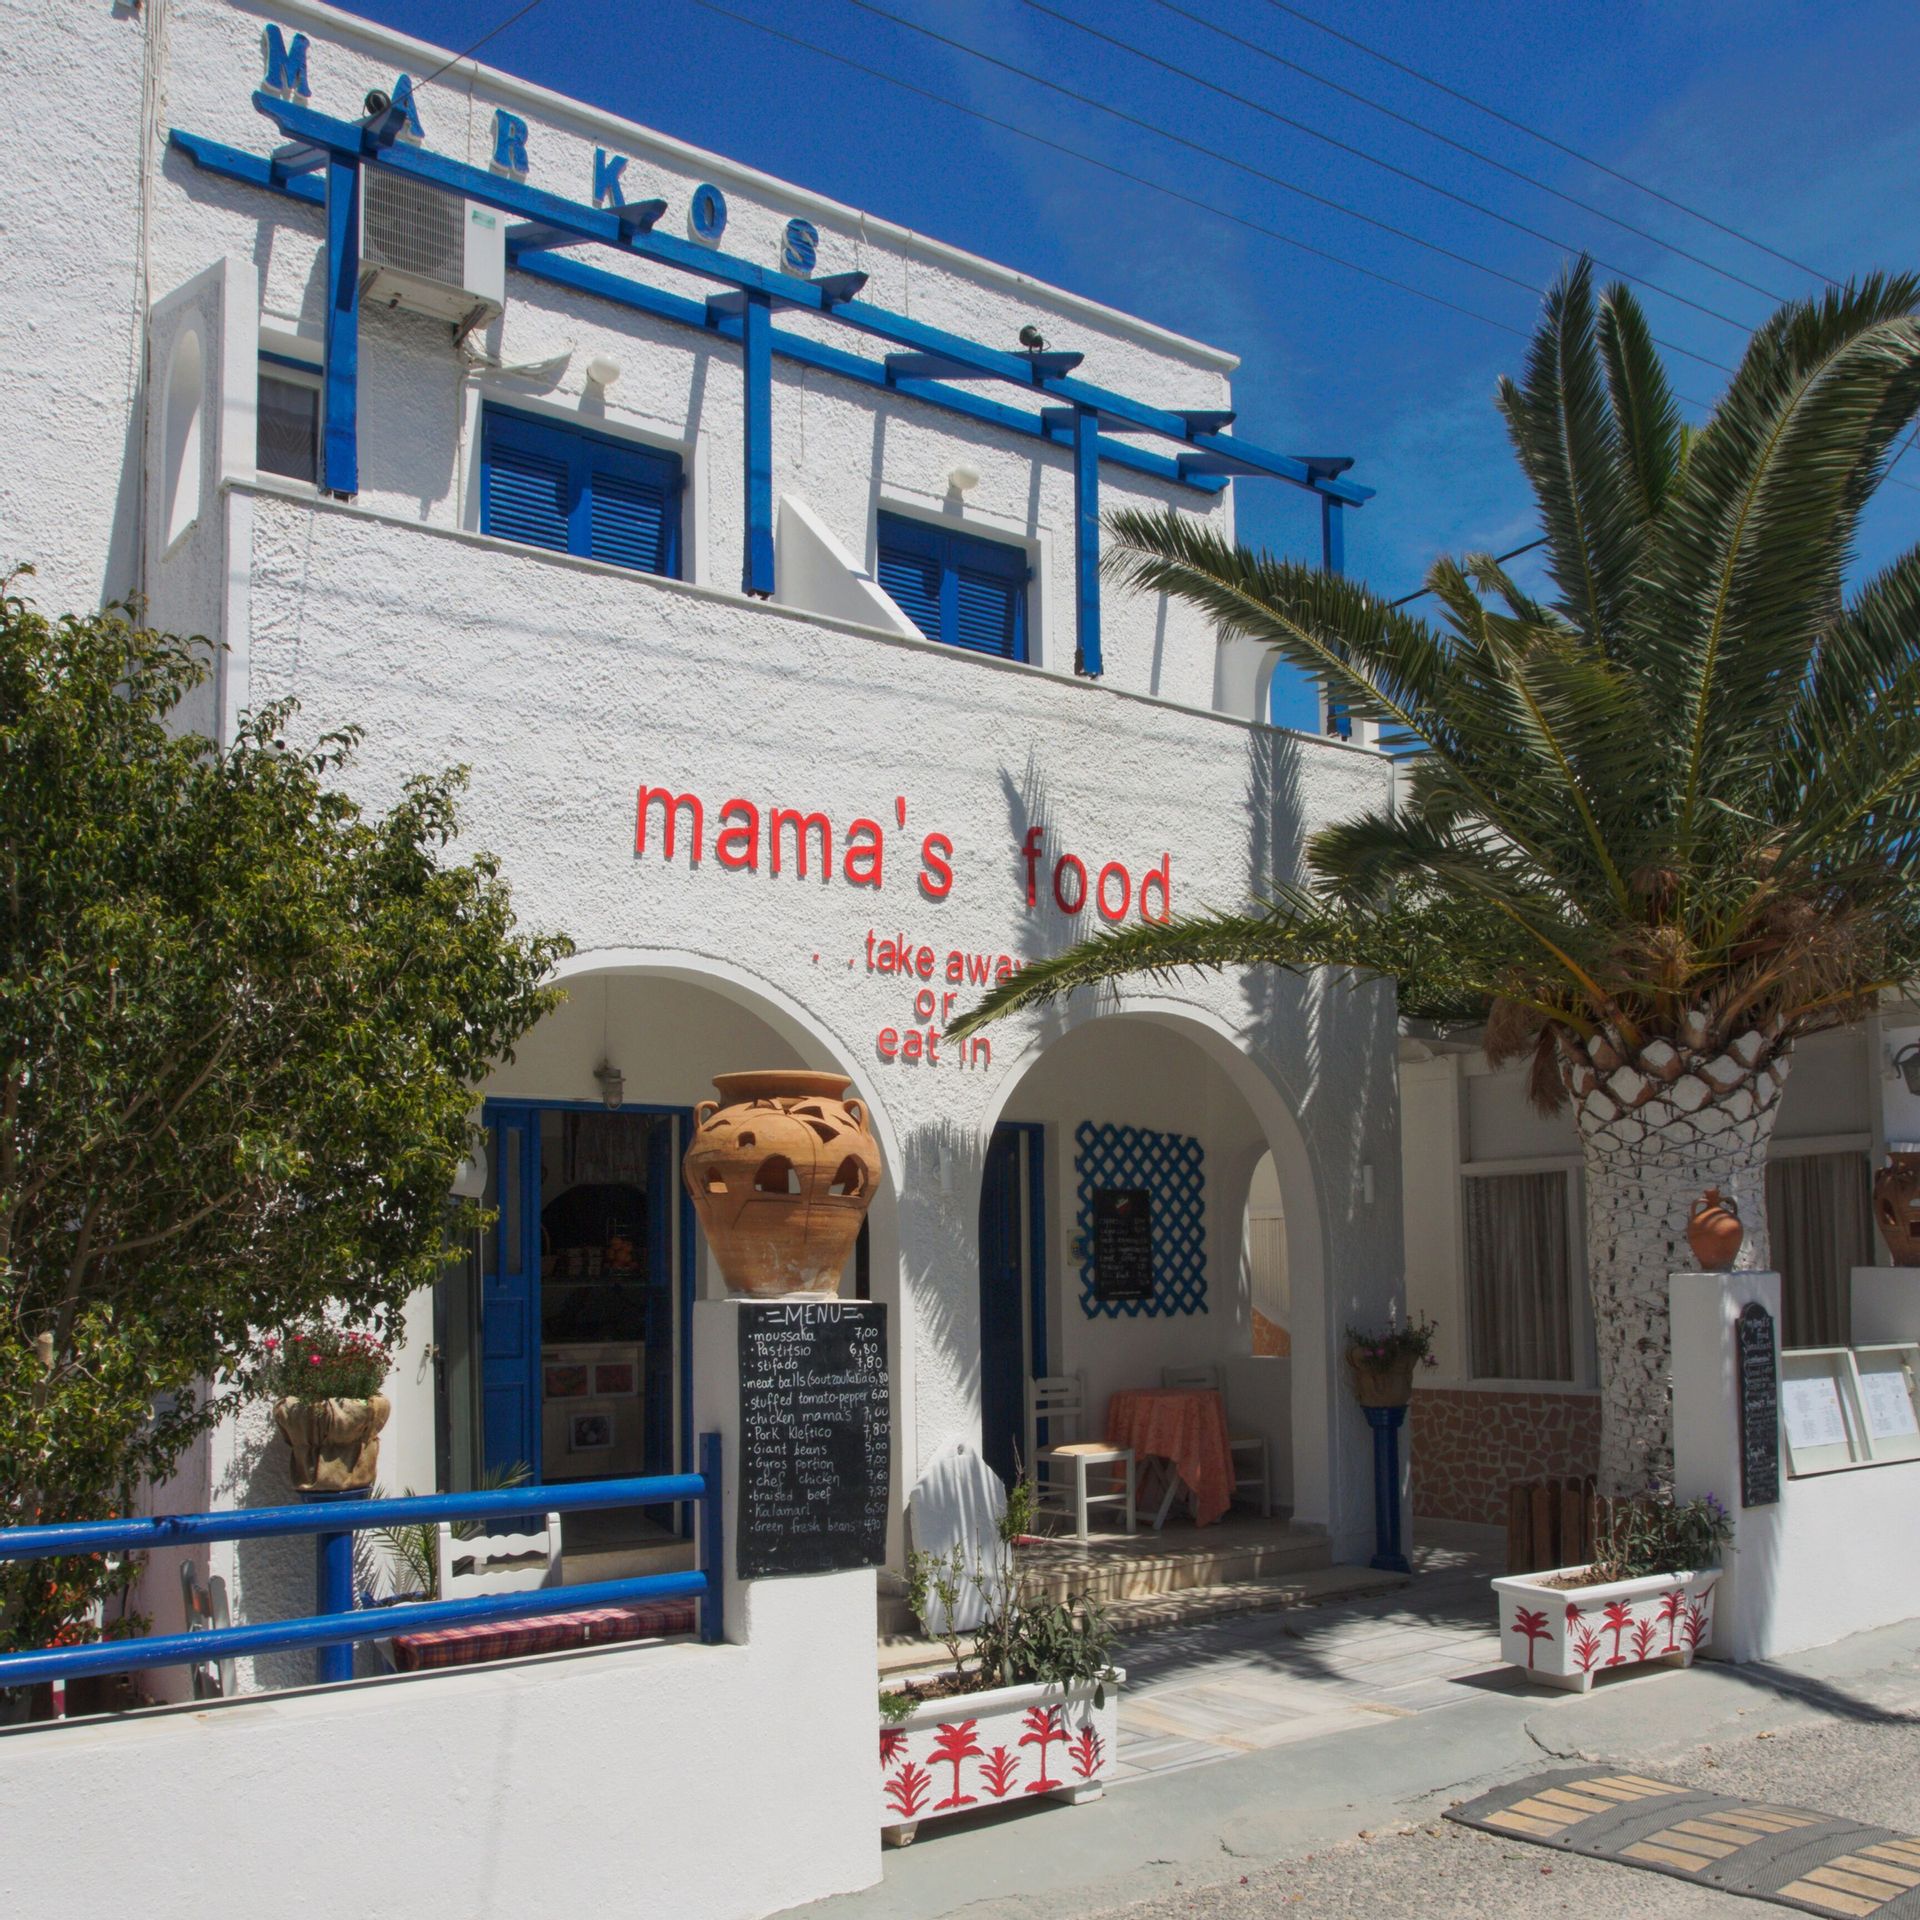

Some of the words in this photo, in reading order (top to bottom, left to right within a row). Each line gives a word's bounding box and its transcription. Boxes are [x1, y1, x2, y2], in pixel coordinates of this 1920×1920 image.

[265, 23, 818, 273] MARKOS
[636, 784, 954, 897] mama's
[1021, 826, 1170, 924] food
[866, 928, 936, 977] take
[916, 988, 958, 1018] or
[878, 1025, 941, 1061] eat
[960, 1036, 992, 1064] in
[854, 1327, 878, 1341] 7,00
[849, 1343, 878, 1357] 6,80
[757, 1358, 798, 1375] stifado
[747, 1376, 775, 1389] meat
[779, 1371, 806, 1389] balls
[868, 1371, 888, 1385] 6,80
[750, 1392, 793, 1413] stuffed
[871, 1388, 888, 1400] 6,00
[753, 1442, 787, 1455] Giant
[793, 1441, 828, 1456] beans
[755, 1457, 787, 1475] Gyros
[795, 1457, 834, 1474] portion
[756, 1471, 785, 1490] chef
[807, 1486, 832, 1504] beef
[755, 1502, 810, 1517] Kalamari
[755, 1520, 784, 1535] Green
[791, 1516, 821, 1533] fresh
